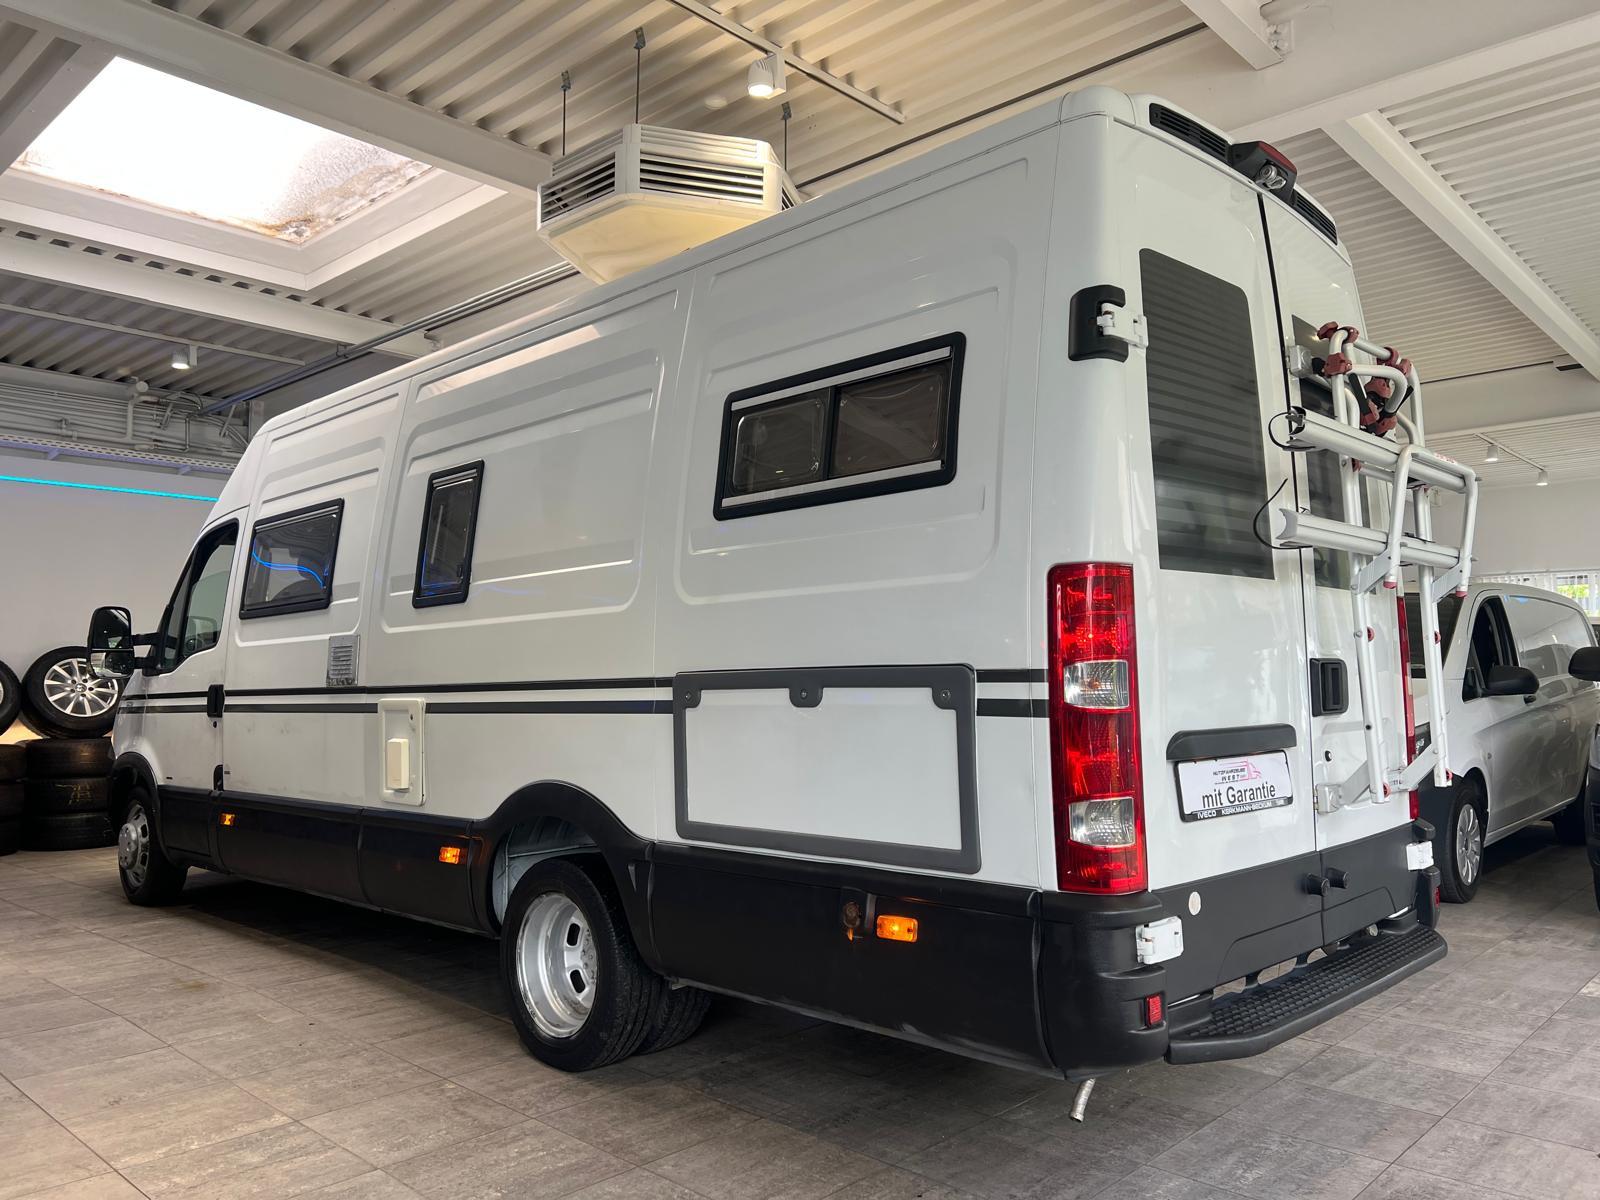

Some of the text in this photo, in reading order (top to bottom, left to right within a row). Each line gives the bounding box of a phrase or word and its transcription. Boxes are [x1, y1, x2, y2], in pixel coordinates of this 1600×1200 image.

[1202, 781, 1276, 808] mit Garantie
[1197, 810, 1217, 820] IVECO
